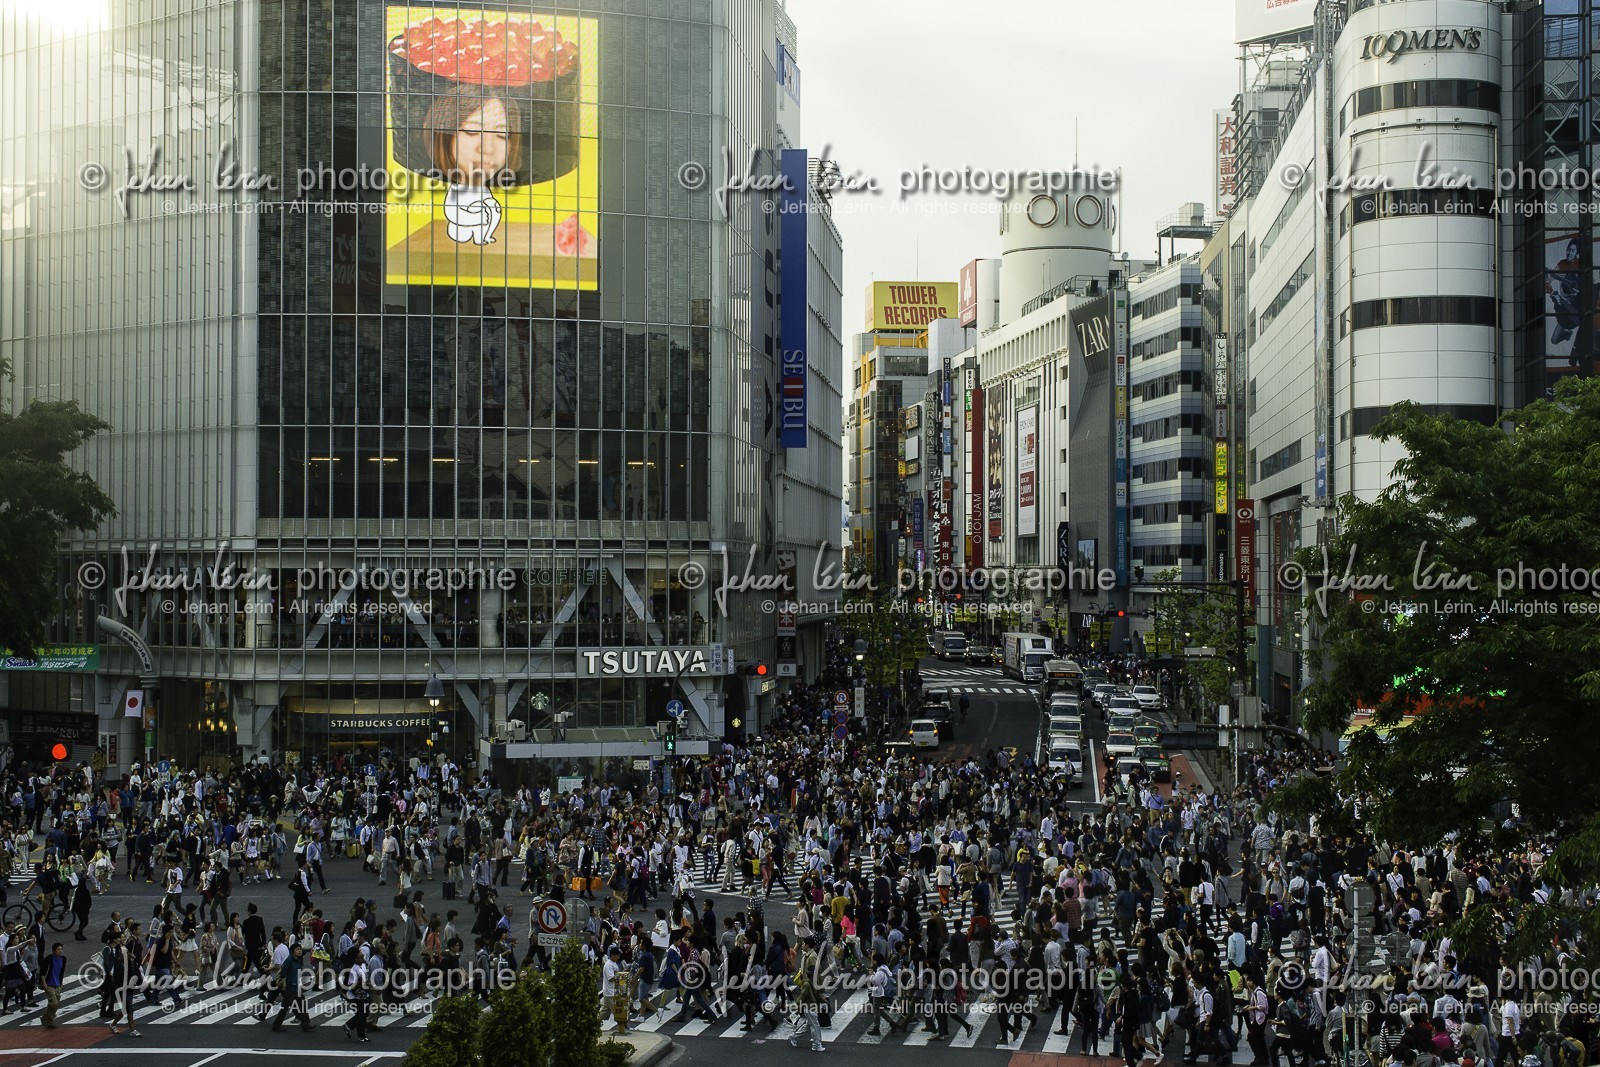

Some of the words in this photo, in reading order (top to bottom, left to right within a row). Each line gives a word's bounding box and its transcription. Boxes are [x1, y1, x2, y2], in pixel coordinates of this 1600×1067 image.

[888, 285, 938, 305] TOWER
[926, 392, 936, 454] KARAOKE
[582, 650, 707, 674] TSUTAYA
[330, 718, 392, 728] STARBUCKS
[394, 716, 428, 727] COFFEE
